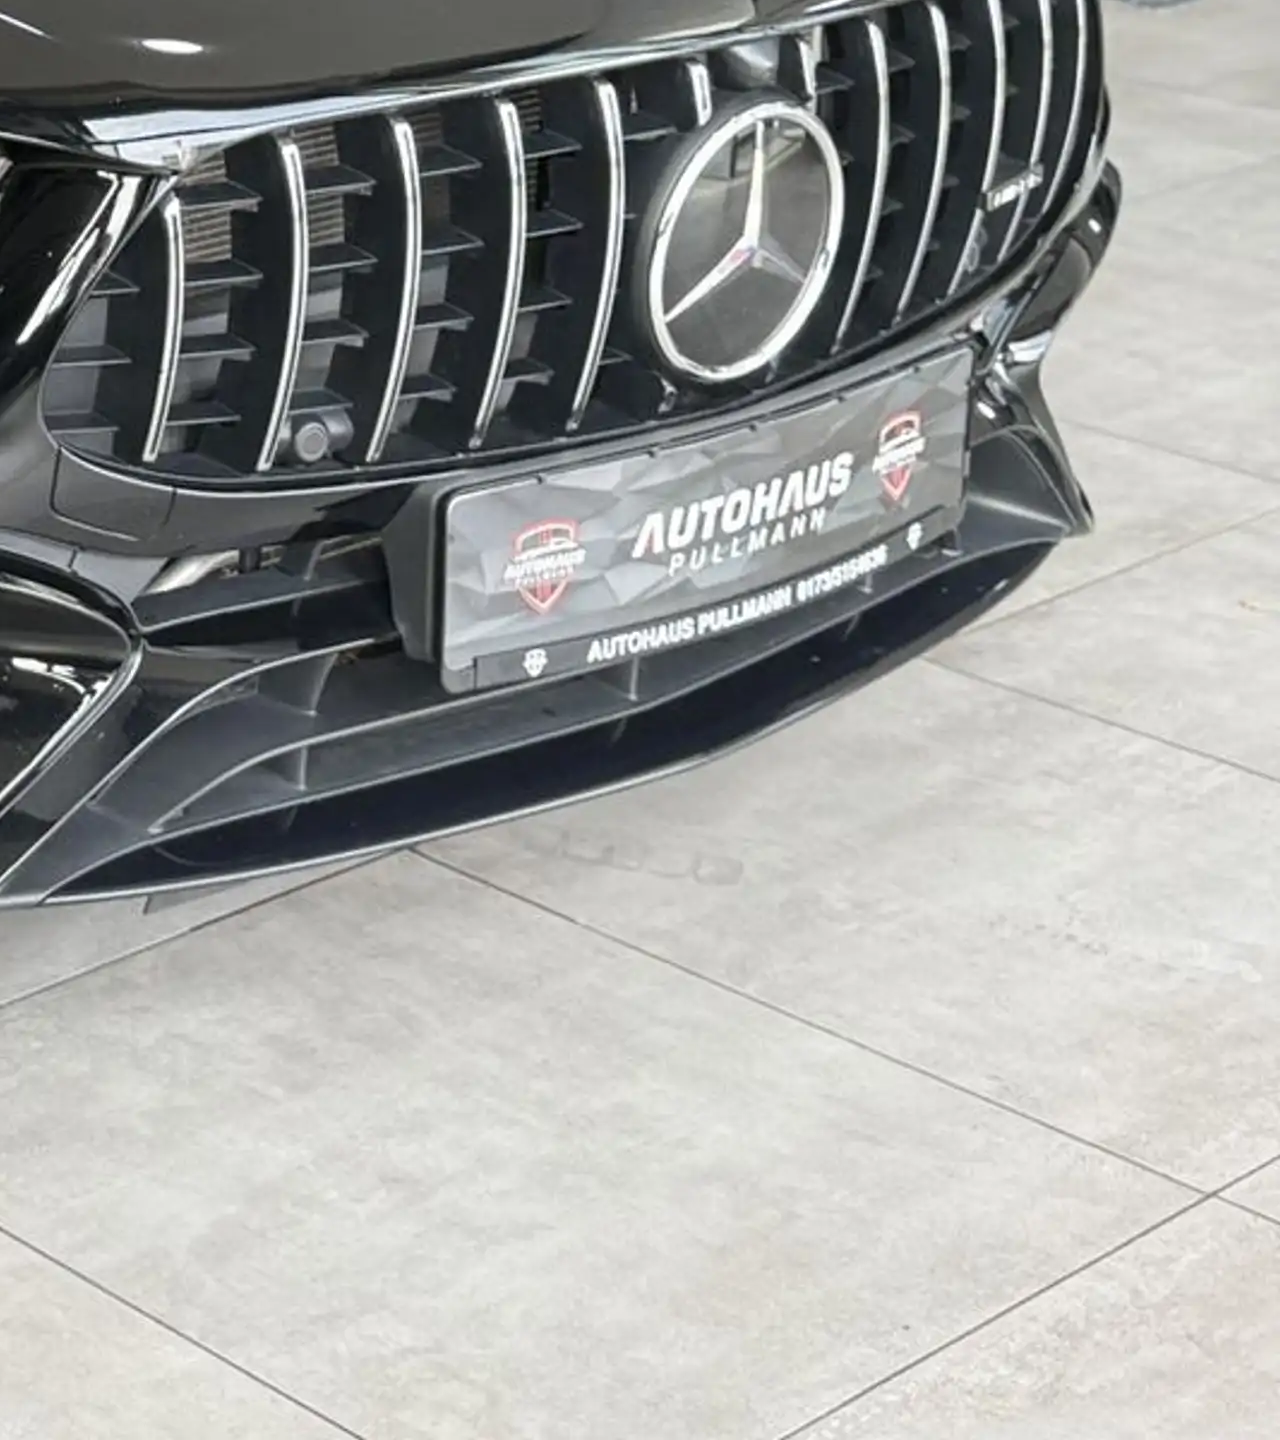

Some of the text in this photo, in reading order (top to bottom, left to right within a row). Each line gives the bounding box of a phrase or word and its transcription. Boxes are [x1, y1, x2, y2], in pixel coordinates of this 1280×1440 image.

[632, 452, 855, 559] AUTOHAUS
[667, 506, 827, 577] PULLMANN
[587, 617, 696, 664] AUTOHAUS
[698, 586, 791, 636] PULLMANN
